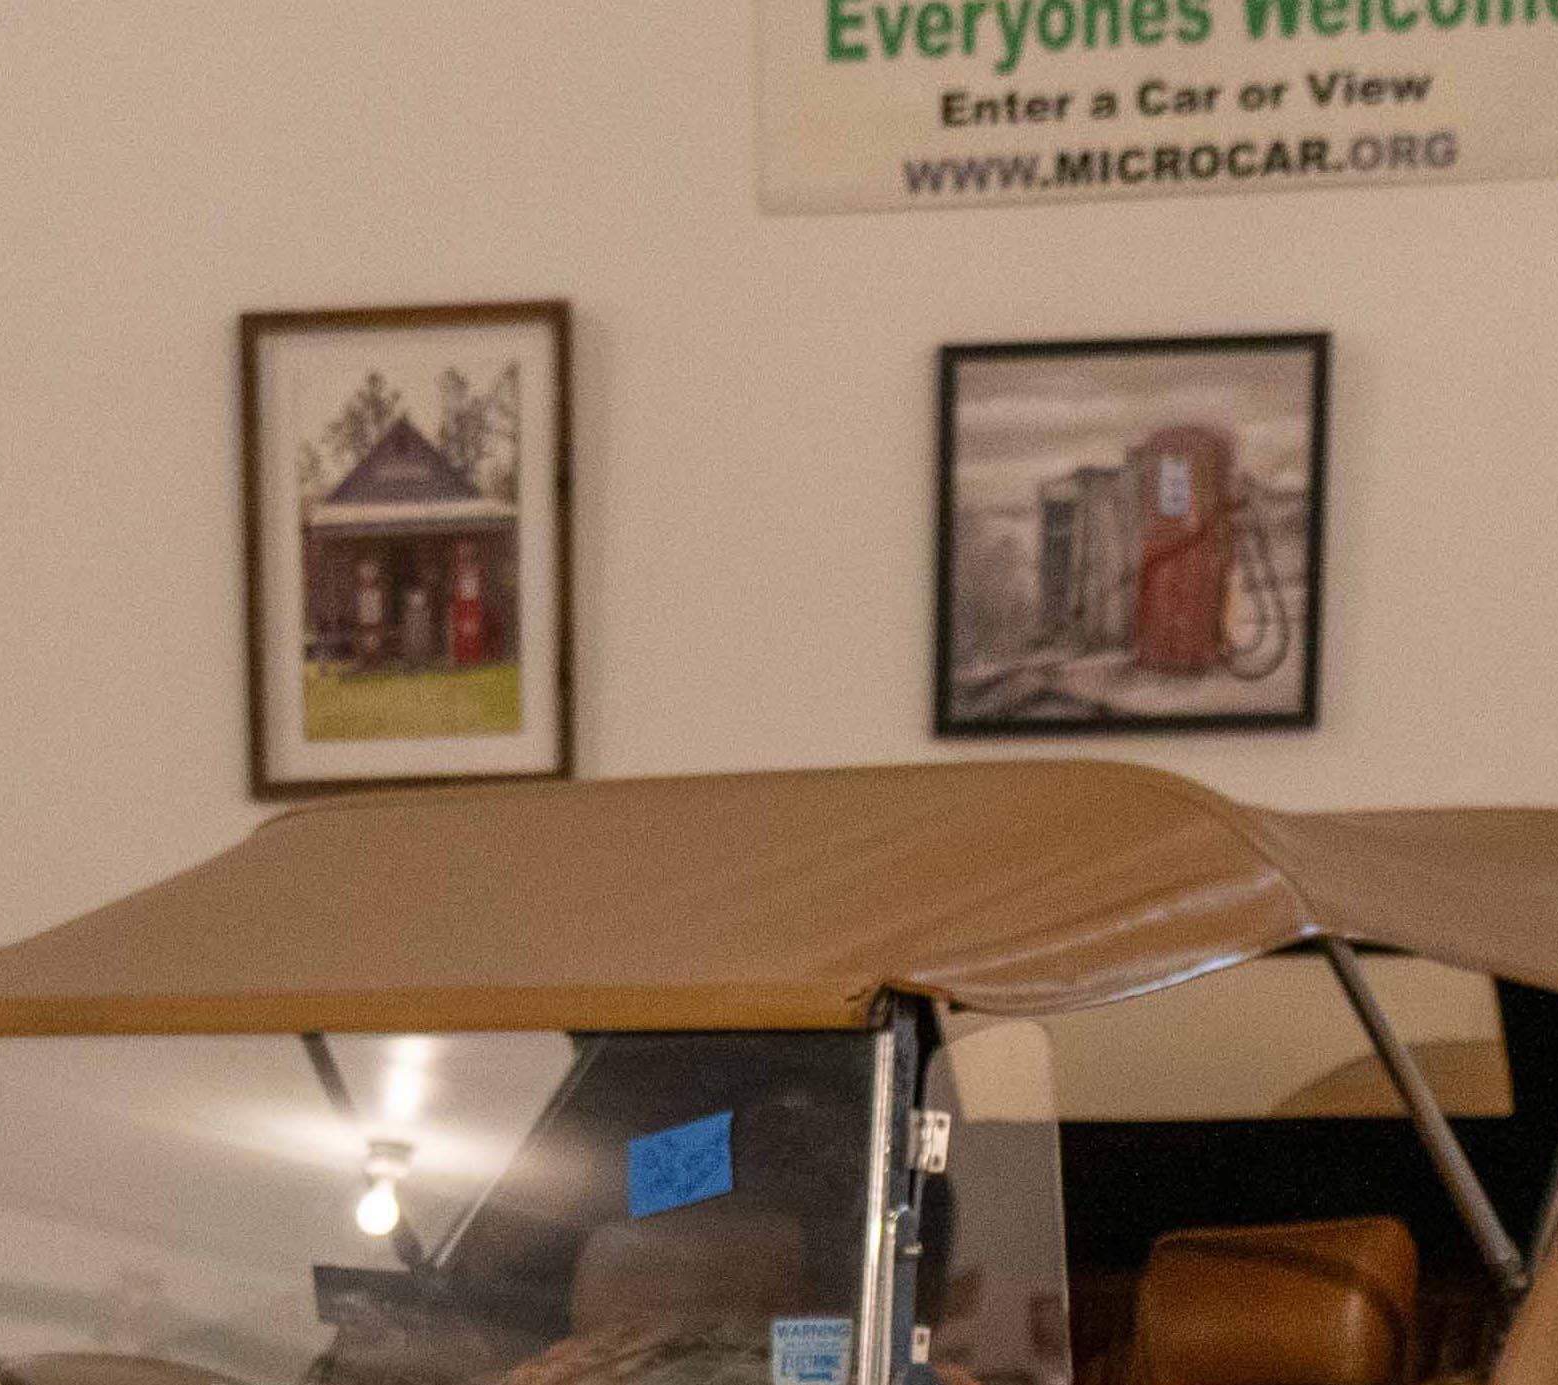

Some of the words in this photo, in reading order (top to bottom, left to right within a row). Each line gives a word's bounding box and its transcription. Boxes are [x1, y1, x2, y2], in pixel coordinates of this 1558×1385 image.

[826, 0, 1212, 75] Everyones
[940, 89, 1071, 127] Enter
[1090, 92, 1117, 120] a
[1137, 79, 1219, 115] Car
[1238, 81, 1287, 112] or
[1307, 70, 1433, 105] View
[903, 127, 1459, 193] WWW.MICROCAR.ORG
